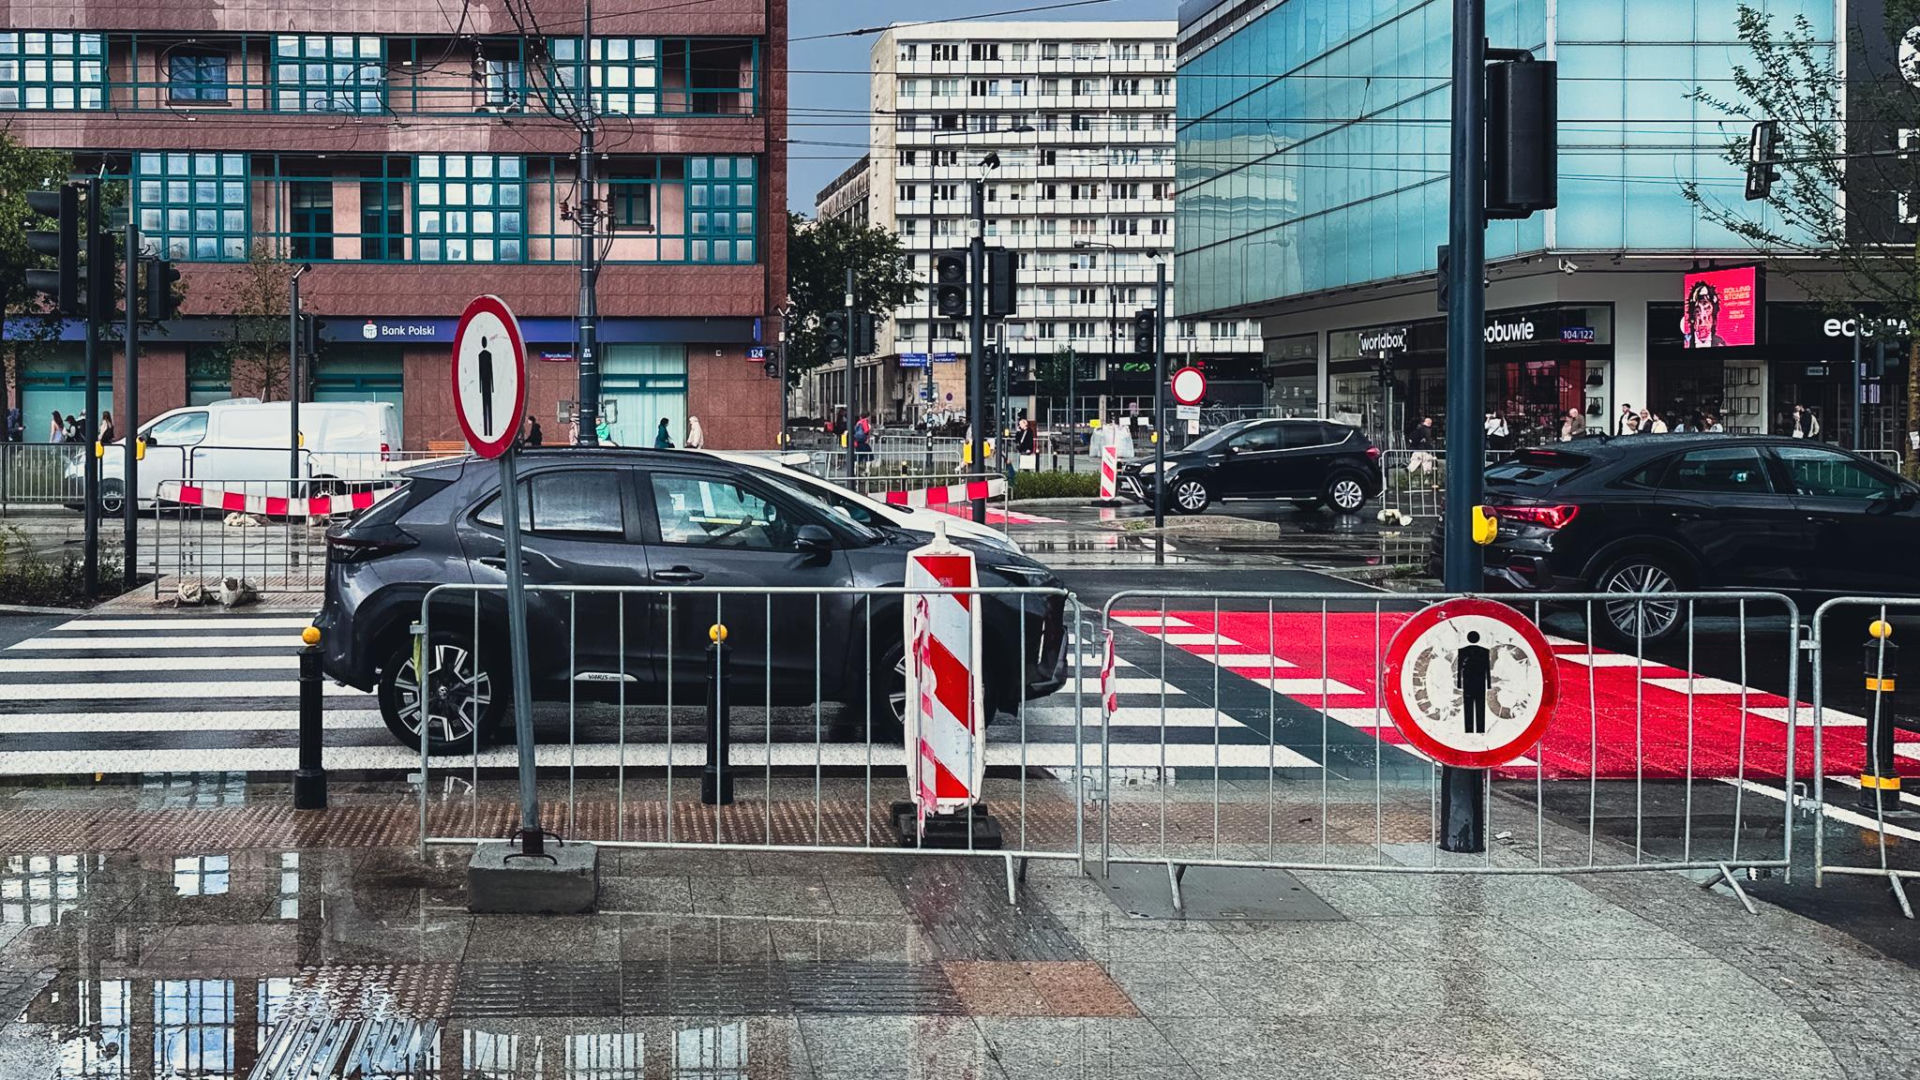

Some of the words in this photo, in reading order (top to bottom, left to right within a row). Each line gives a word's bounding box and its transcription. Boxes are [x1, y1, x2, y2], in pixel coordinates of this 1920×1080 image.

[1724, 285, 1751, 293] ROLLING
[1724, 292, 1750, 300] STONES
[382, 325, 406, 335] Bank
[408, 325, 435, 335] Polski
[1484, 317, 1534, 342] obuwie
[1563, 330, 1594, 339] 104/122
[751, 349, 763, 358] 124
